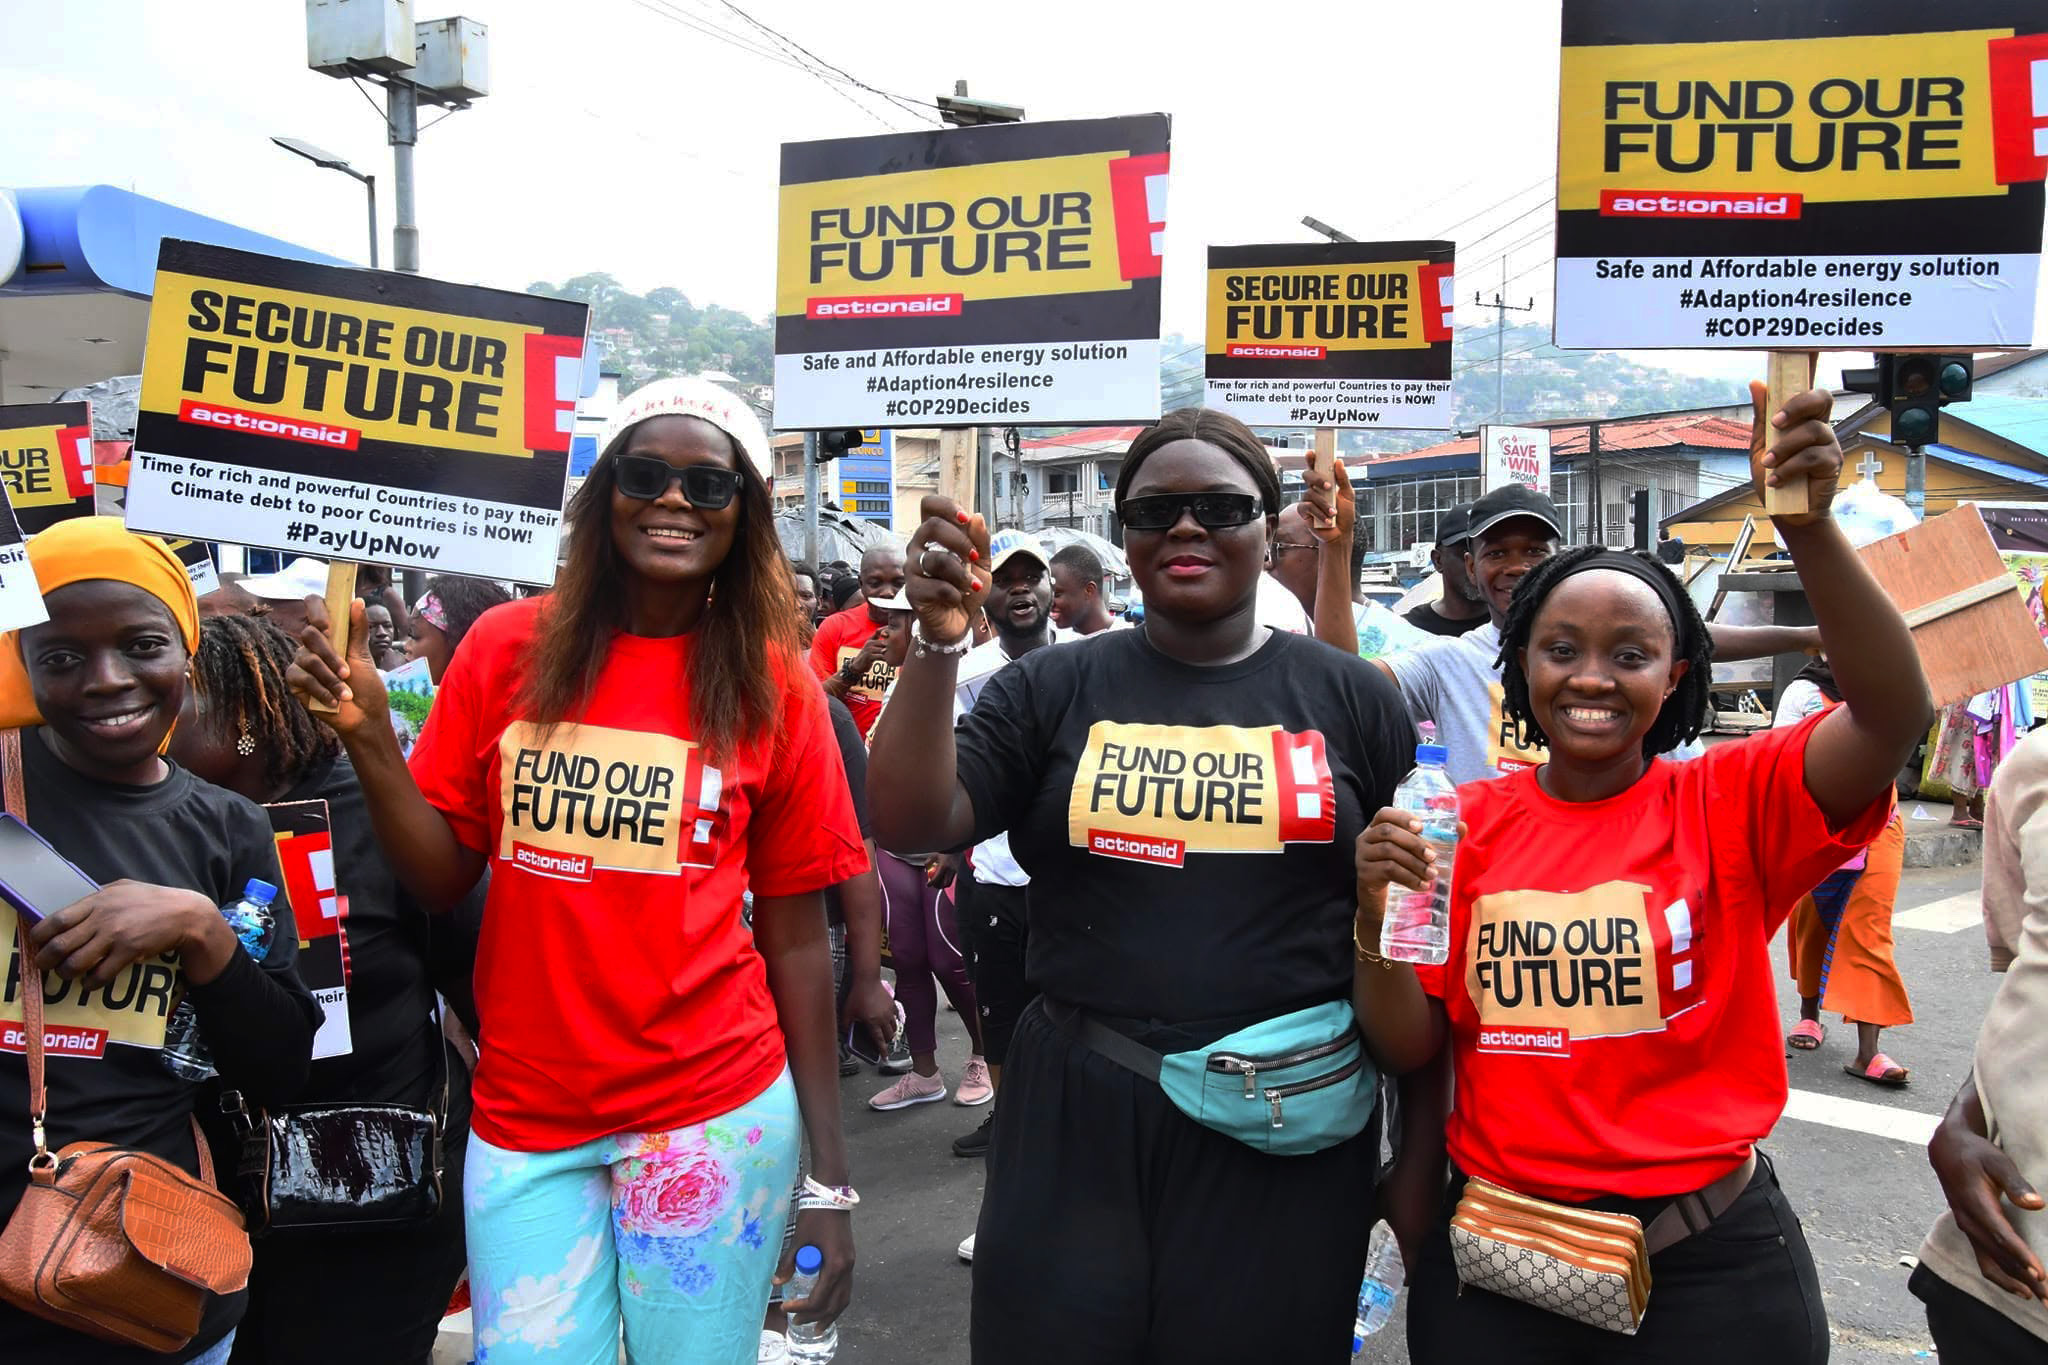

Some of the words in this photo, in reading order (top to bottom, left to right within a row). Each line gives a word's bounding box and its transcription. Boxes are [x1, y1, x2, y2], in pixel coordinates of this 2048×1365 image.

[1605, 81, 1793, 120] FUND
[1809, 77, 1964, 119] OUR
[1604, 120, 1963, 173] FUTURE
[811, 202, 955, 241] FUND
[967, 192, 1091, 230] OUR
[810, 227, 1091, 284] FUTURE
[1596, 260, 1644, 278] Safe
[1652, 260, 1692, 278] and
[1700, 259, 1817, 278] Affordable
[1825, 263, 1902, 281] energy
[1910, 257, 1999, 276] solution
[1226, 275, 1339, 301] SECURE
[1347, 274, 1408, 300] OUR
[1680, 288, 1911, 312] #Adaption4resilence
[188, 290, 394, 360] SECURE
[404, 326, 506, 378] OUR
[1227, 304, 1408, 339] FUTURE
[1706, 318, 1883, 337] #COP29Decides
[804, 354, 839, 370] Safe
[846, 352, 876, 368] and
[882, 348, 974, 367] Affordable
[982, 350, 1045, 366] energy
[1052, 344, 1127, 361] solution
[182, 337, 503, 437] FUTURE
[867, 372, 1053, 395] #Adaption4resilence
[1208, 380, 1232, 389] Time
[1234, 380, 1248, 390] for
[1250, 381, 1269, 390] rich
[1271, 381, 1290, 390] and
[1293, 381, 1336, 392] powerful
[1339, 381, 1388, 391] Countries
[1390, 382, 1402, 391] to
[1404, 383, 1423, 394] pay
[1425, 382, 1451, 392] their
[1225, 392, 1266, 403] Climate
[1268, 393, 1292, 403] debt
[1295, 394, 1306, 403] to
[1309, 395, 1333, 405] poor
[1335, 393, 1389, 404] Countries
[1392, 394, 1402, 404] is
[1405, 394, 1436, 405] NOW!
[886, 398, 1029, 416] #COP29Decides
[1291, 408, 1380, 424] #PayUpNow
[0, 448, 49, 469] UR
[1504, 444, 1536, 458] SAVE
[1509, 457, 1539, 476] WIN
[140, 456, 183, 474] Time
[190, 463, 213, 478] for
[219, 468, 252, 484] rich
[258, 476, 290, 489] and
[296, 481, 370, 500] powerful
[377, 490, 456, 512] Countries
[463, 502, 479, 515] to
[485, 508, 514, 523] pay
[520, 510, 558, 526] their
[1511, 471, 1537, 485] PROMO
[171, 482, 244, 504] Climate
[250, 493, 292, 511] debt
[298, 500, 315, 513] to
[322, 506, 364, 520] poor
[370, 509, 456, 533] Countries
[463, 522, 477, 536] is
[484, 525, 532, 543] NOW!
[287, 522, 440, 559] #PayUpNow
[514, 749, 599, 789] FUND
[606, 762, 673, 799] OUR
[1099, 743, 1186, 775] FUND
[1193, 752, 1263, 780] OUR
[512, 784, 668, 846] FUTURE
[1090, 774, 1263, 825] FUTURE
[1477, 921, 1556, 960] FUND
[1564, 918, 1640, 956] OUR
[316, 991, 344, 1004] heir
[1475, 958, 1643, 1008] FUTURE
[3, 1029, 99, 1051] aconaid
